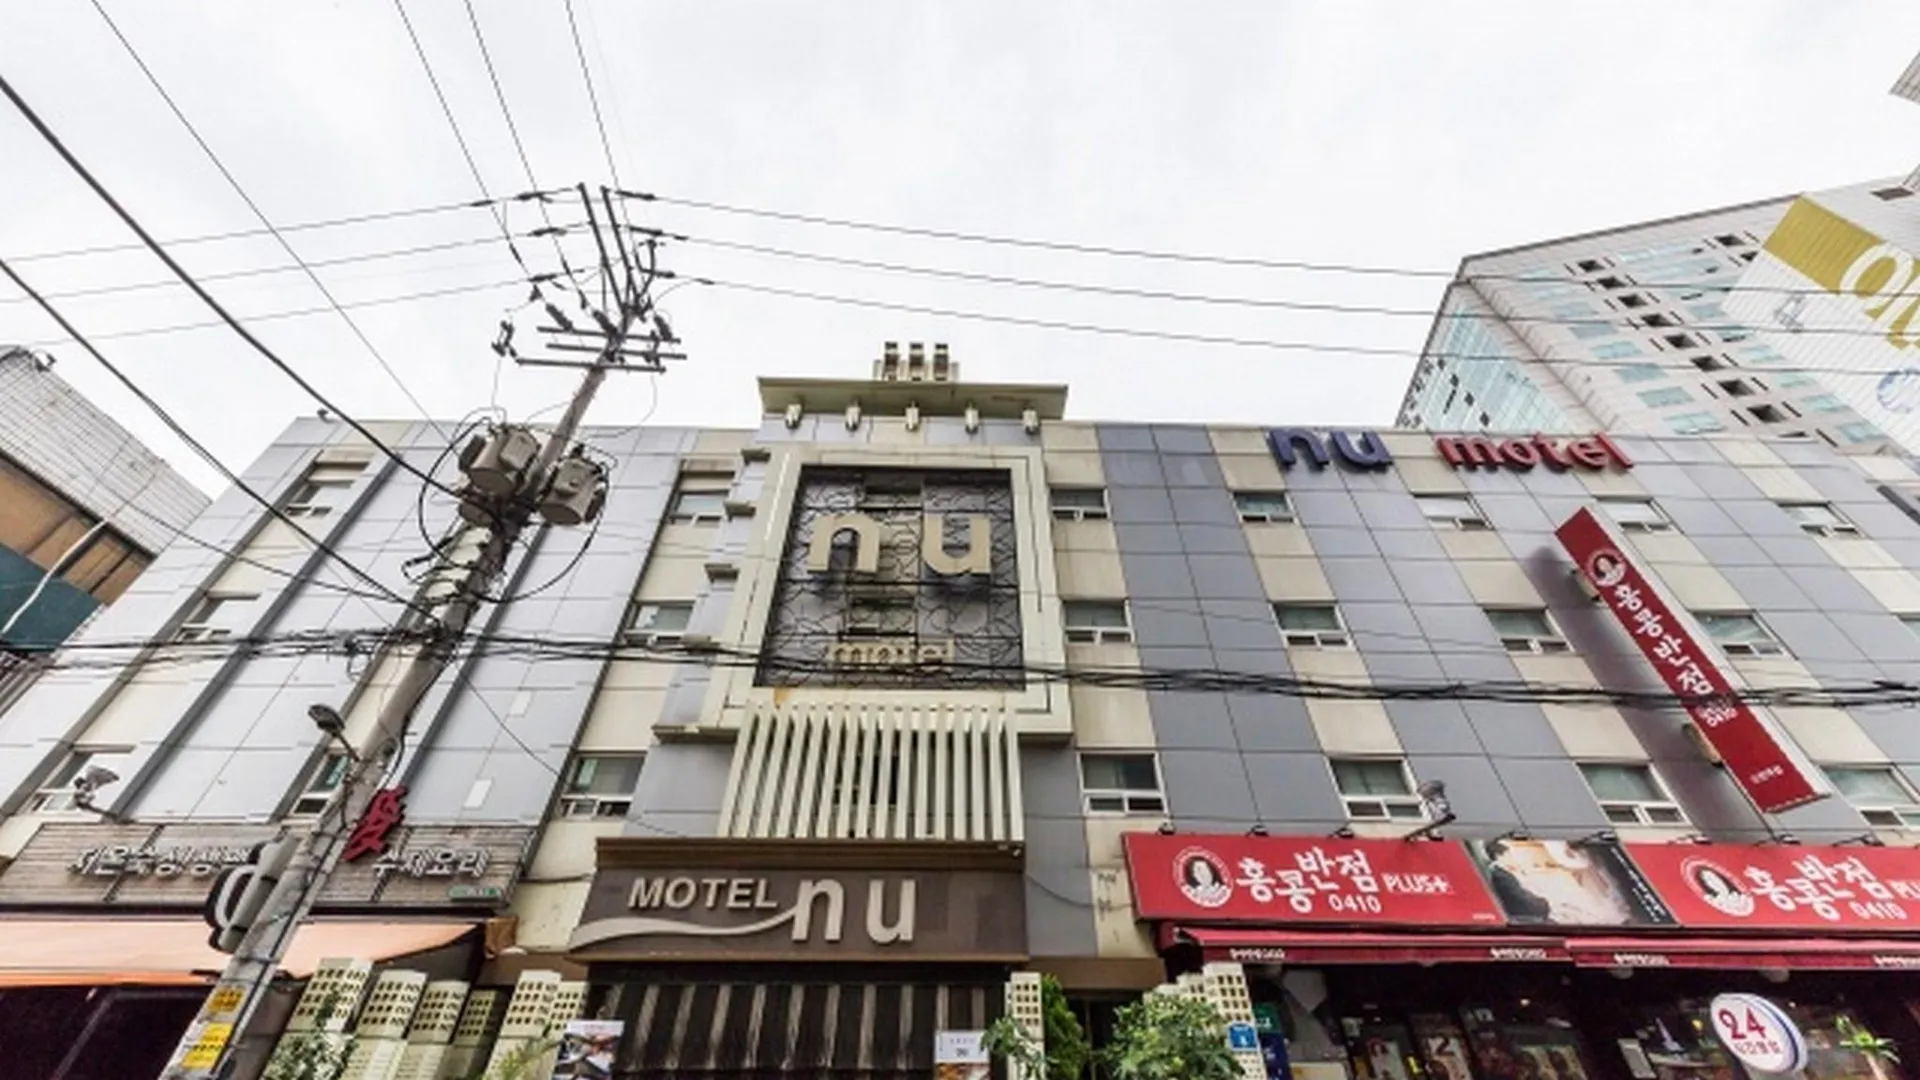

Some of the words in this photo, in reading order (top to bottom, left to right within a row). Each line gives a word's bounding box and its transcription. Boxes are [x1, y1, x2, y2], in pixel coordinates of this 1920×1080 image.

[1268, 430, 1393, 468] nu
[1434, 431, 1633, 470] motel
[806, 510, 992, 575] nu
[828, 638, 955, 672] motel
[1614, 583, 1714, 696] 홍콩반점
[1235, 846, 1381, 914] 홍콩반점
[1328, 894, 1383, 914] 0410
[1743, 853, 1895, 921] 홍콩반점
[627, 876, 778, 910] MOTEL
[791, 878, 916, 944] nu
[1847, 900, 1908, 921] 0410
[1718, 1005, 1767, 1040] 24
